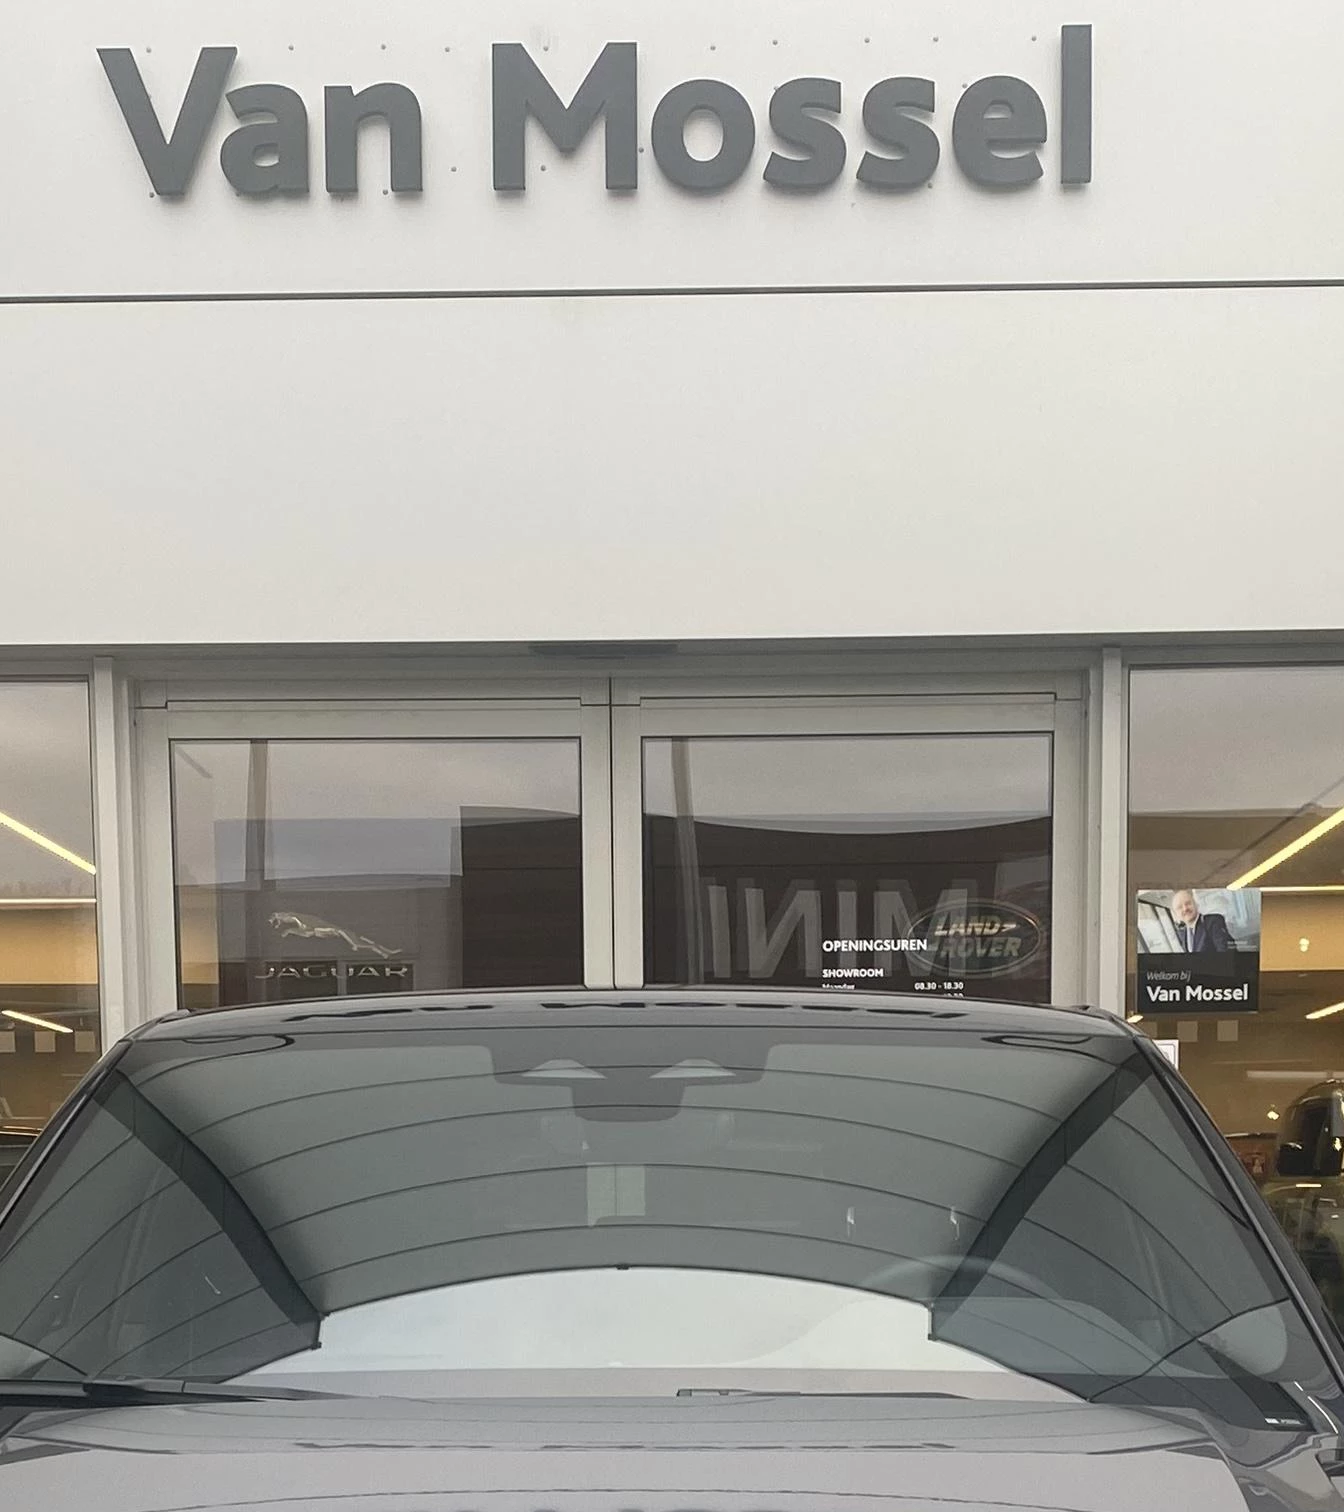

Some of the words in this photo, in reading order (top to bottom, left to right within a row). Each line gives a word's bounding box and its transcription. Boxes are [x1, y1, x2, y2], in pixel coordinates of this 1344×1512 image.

[96, 46, 424, 197] Van
[490, 23, 1093, 193] Mossel
[934, 915, 1001, 937] LAND
[822, 939, 928, 952] OPENINGSUREN
[255, 966, 408, 979] JAGUAR
[822, 968, 884, 978] SHOWROOM
[1146, 970, 1179, 981] Welkom
[1179, 970, 1192, 983] bij
[914, 982, 937, 991] 08.30
[943, 981, 964, 990] 18.30
[1146, 985, 1181, 1002] Van
[1185, 983, 1249, 1002] Mossel
